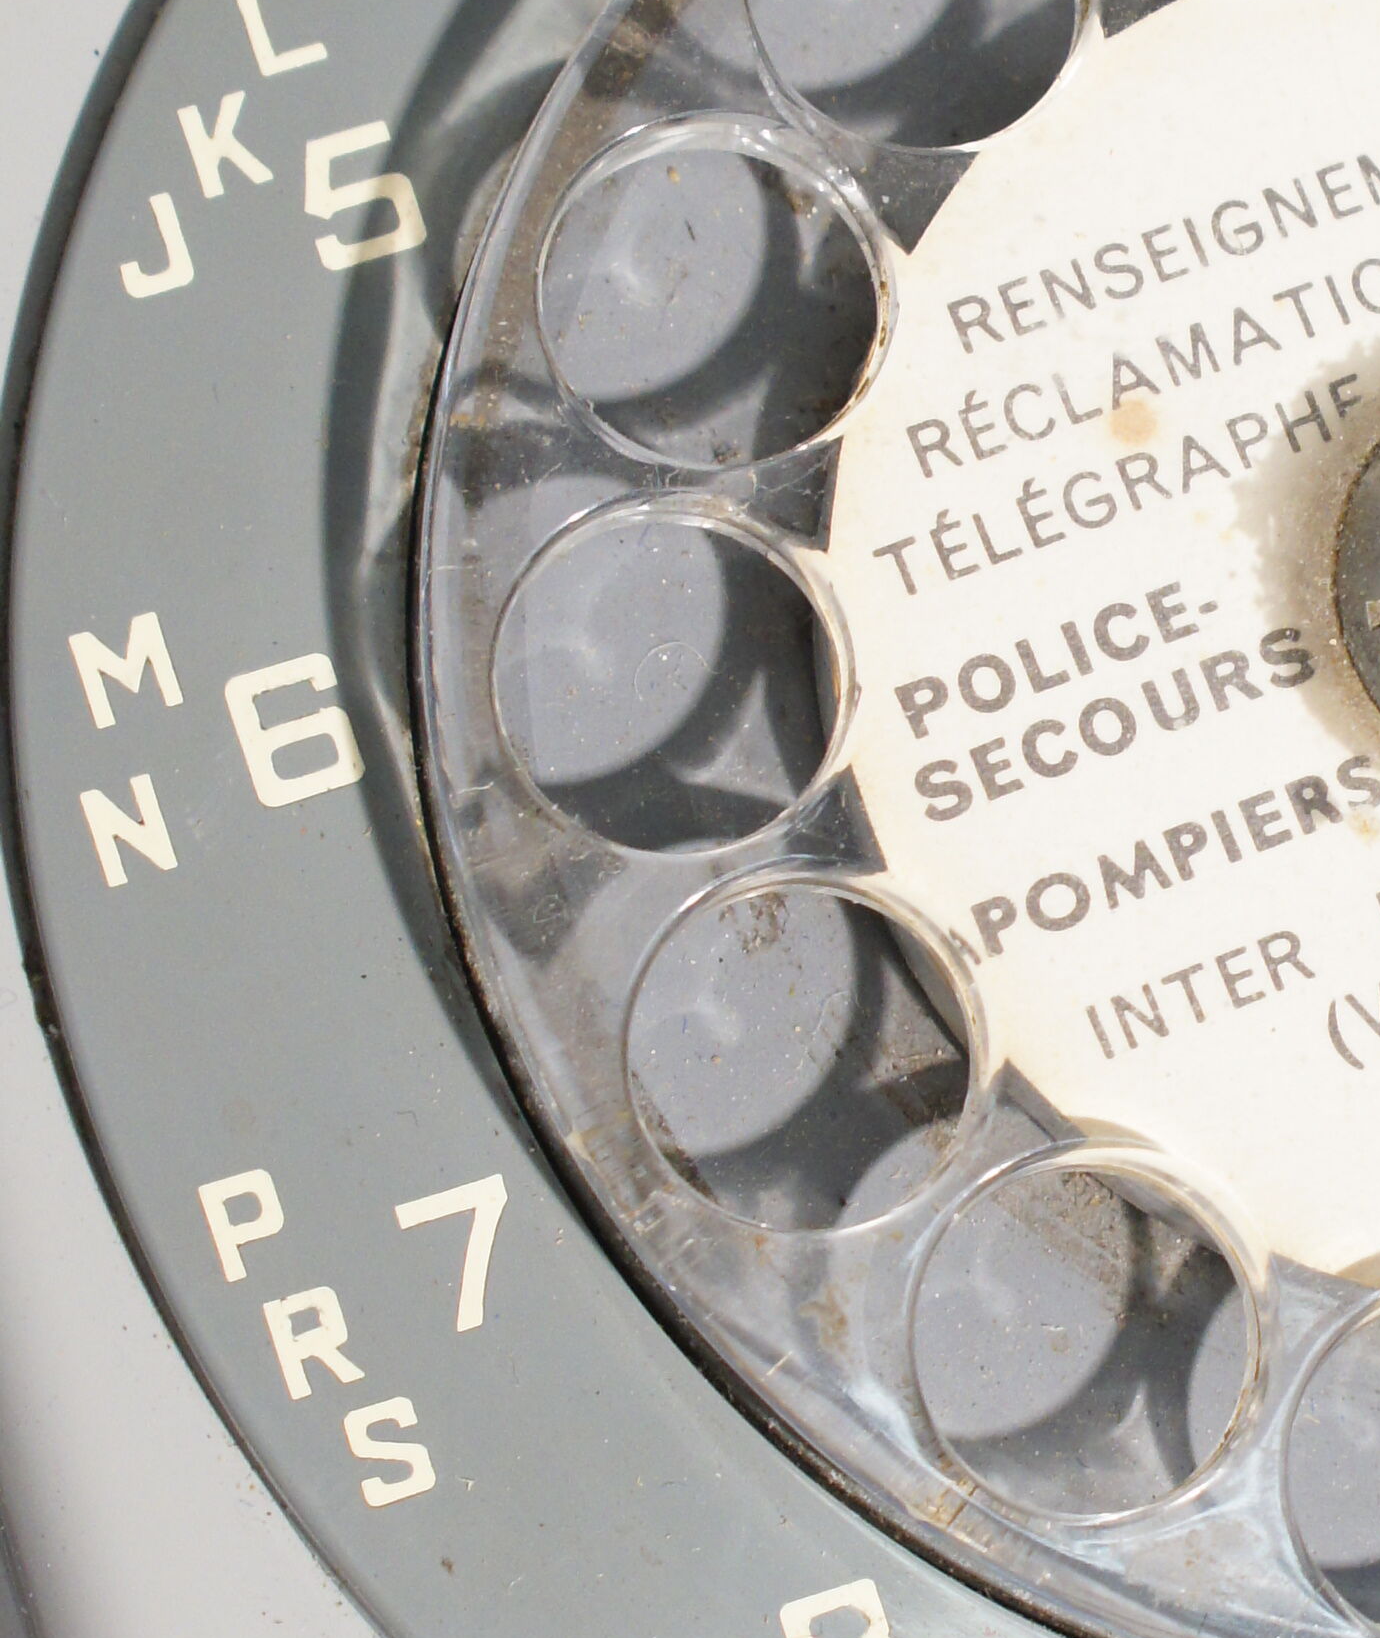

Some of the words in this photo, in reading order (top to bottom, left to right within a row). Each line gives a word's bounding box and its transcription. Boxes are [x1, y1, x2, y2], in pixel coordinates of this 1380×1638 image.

[304, 120, 427, 271] 5
[223, 652, 364, 808] 6
[895, 581, 1218, 738] POLICE-
[914, 627, 1315, 822] SECOURS
[1087, 930, 1316, 1060] INTER
[395, 1173, 508, 1332] 7
